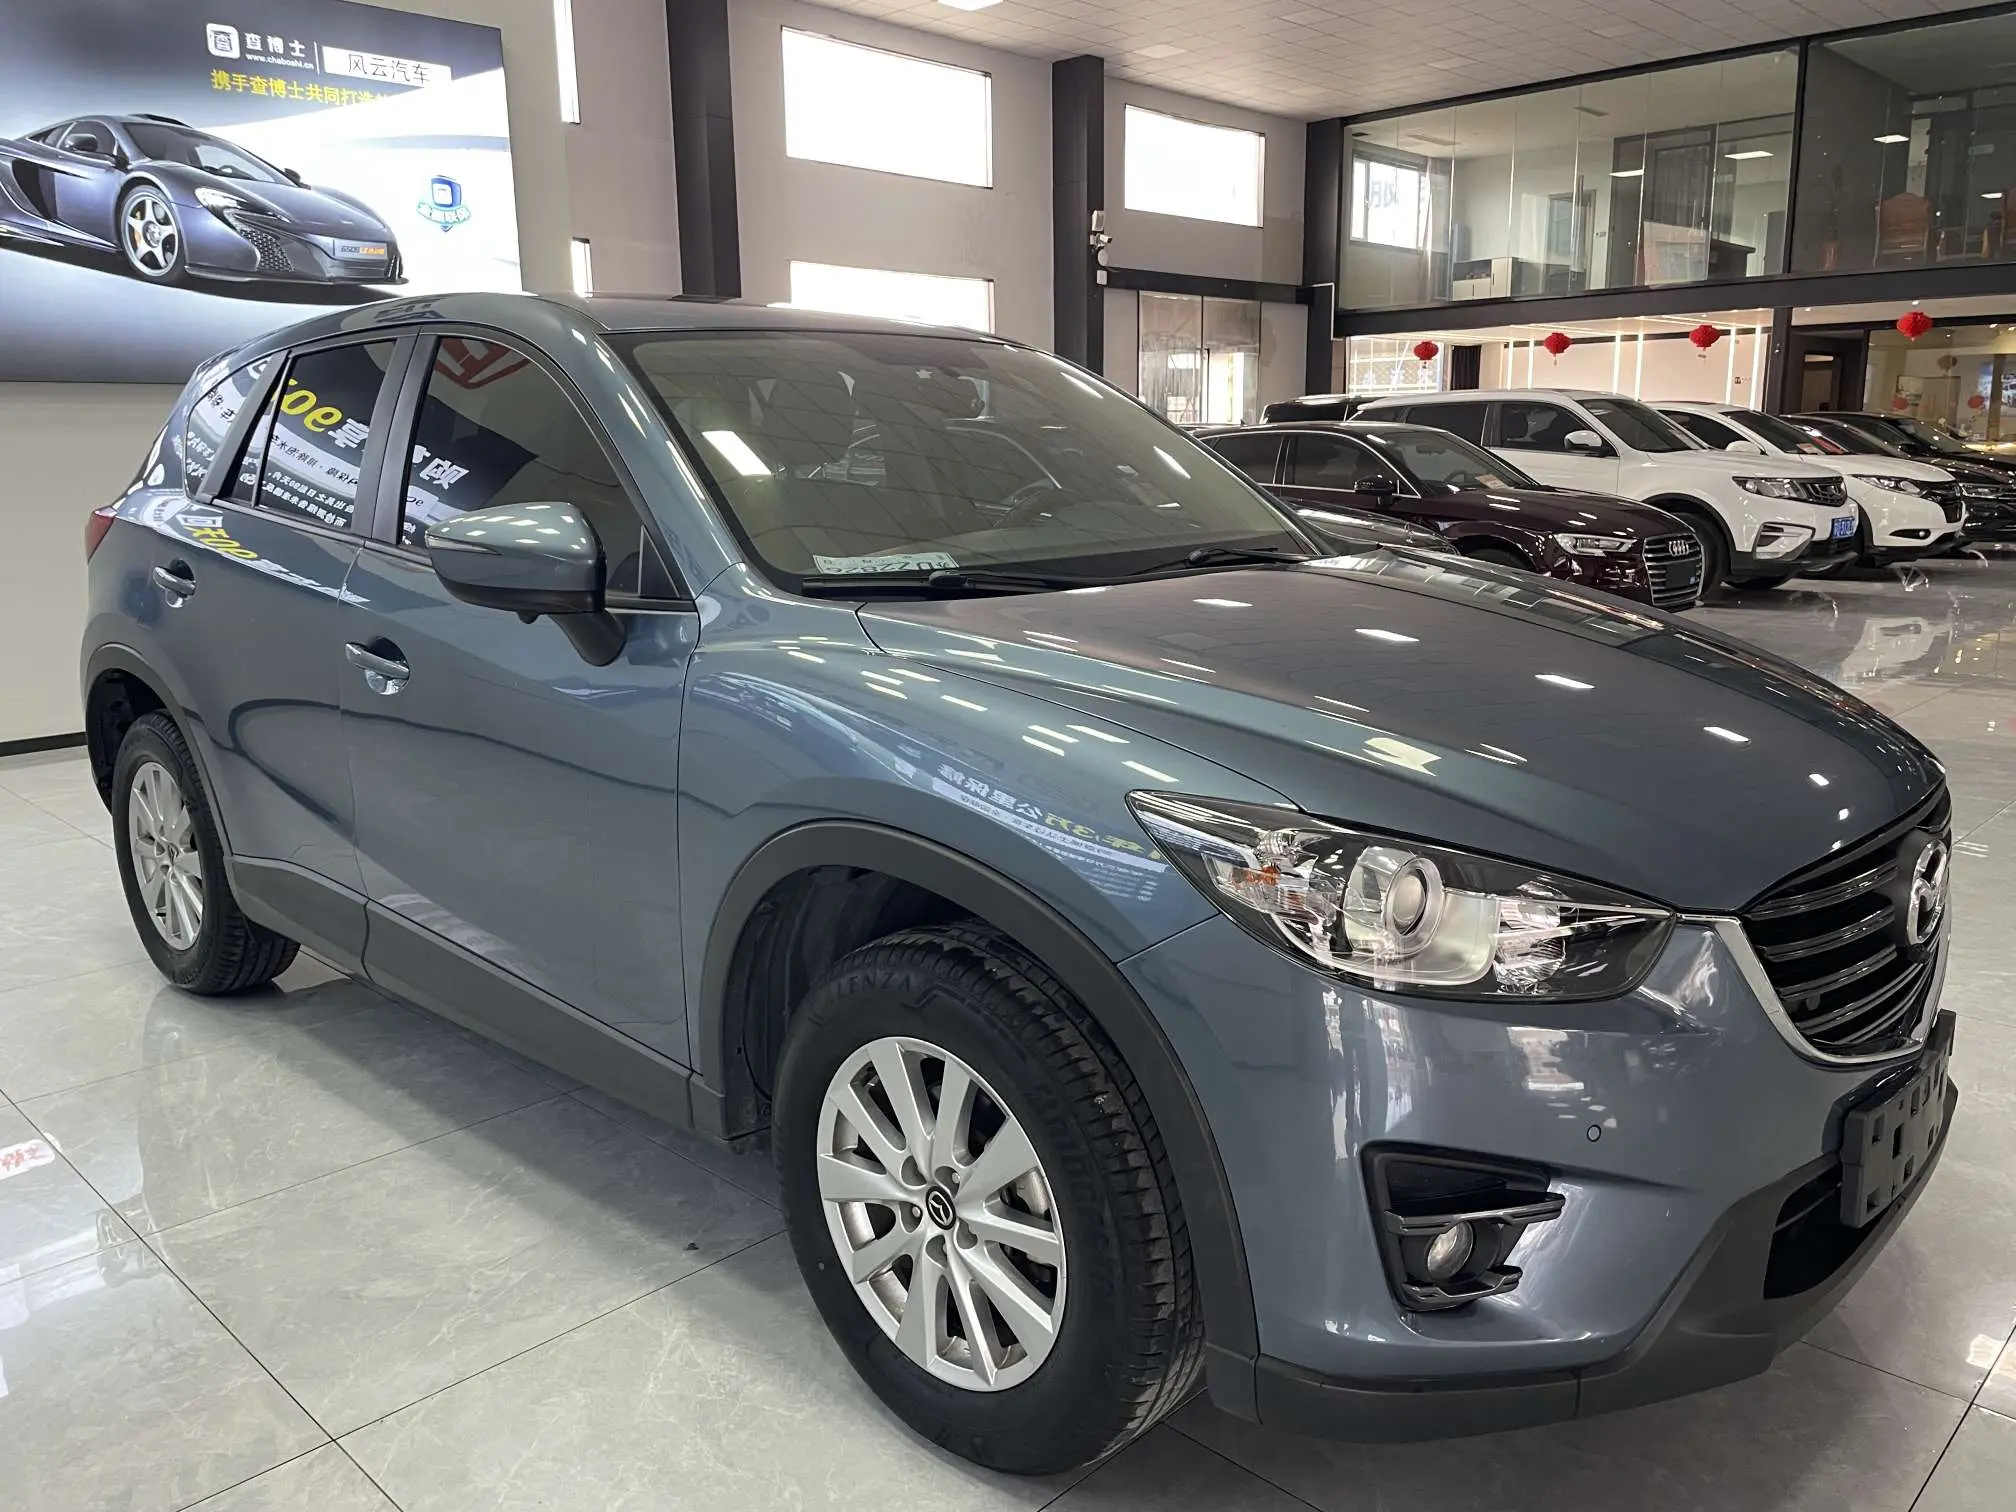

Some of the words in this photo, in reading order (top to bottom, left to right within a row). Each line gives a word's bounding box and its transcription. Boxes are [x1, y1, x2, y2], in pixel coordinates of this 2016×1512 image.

[244, 32, 306, 58] 查博士
[347, 52, 431, 83] 风云汽车
